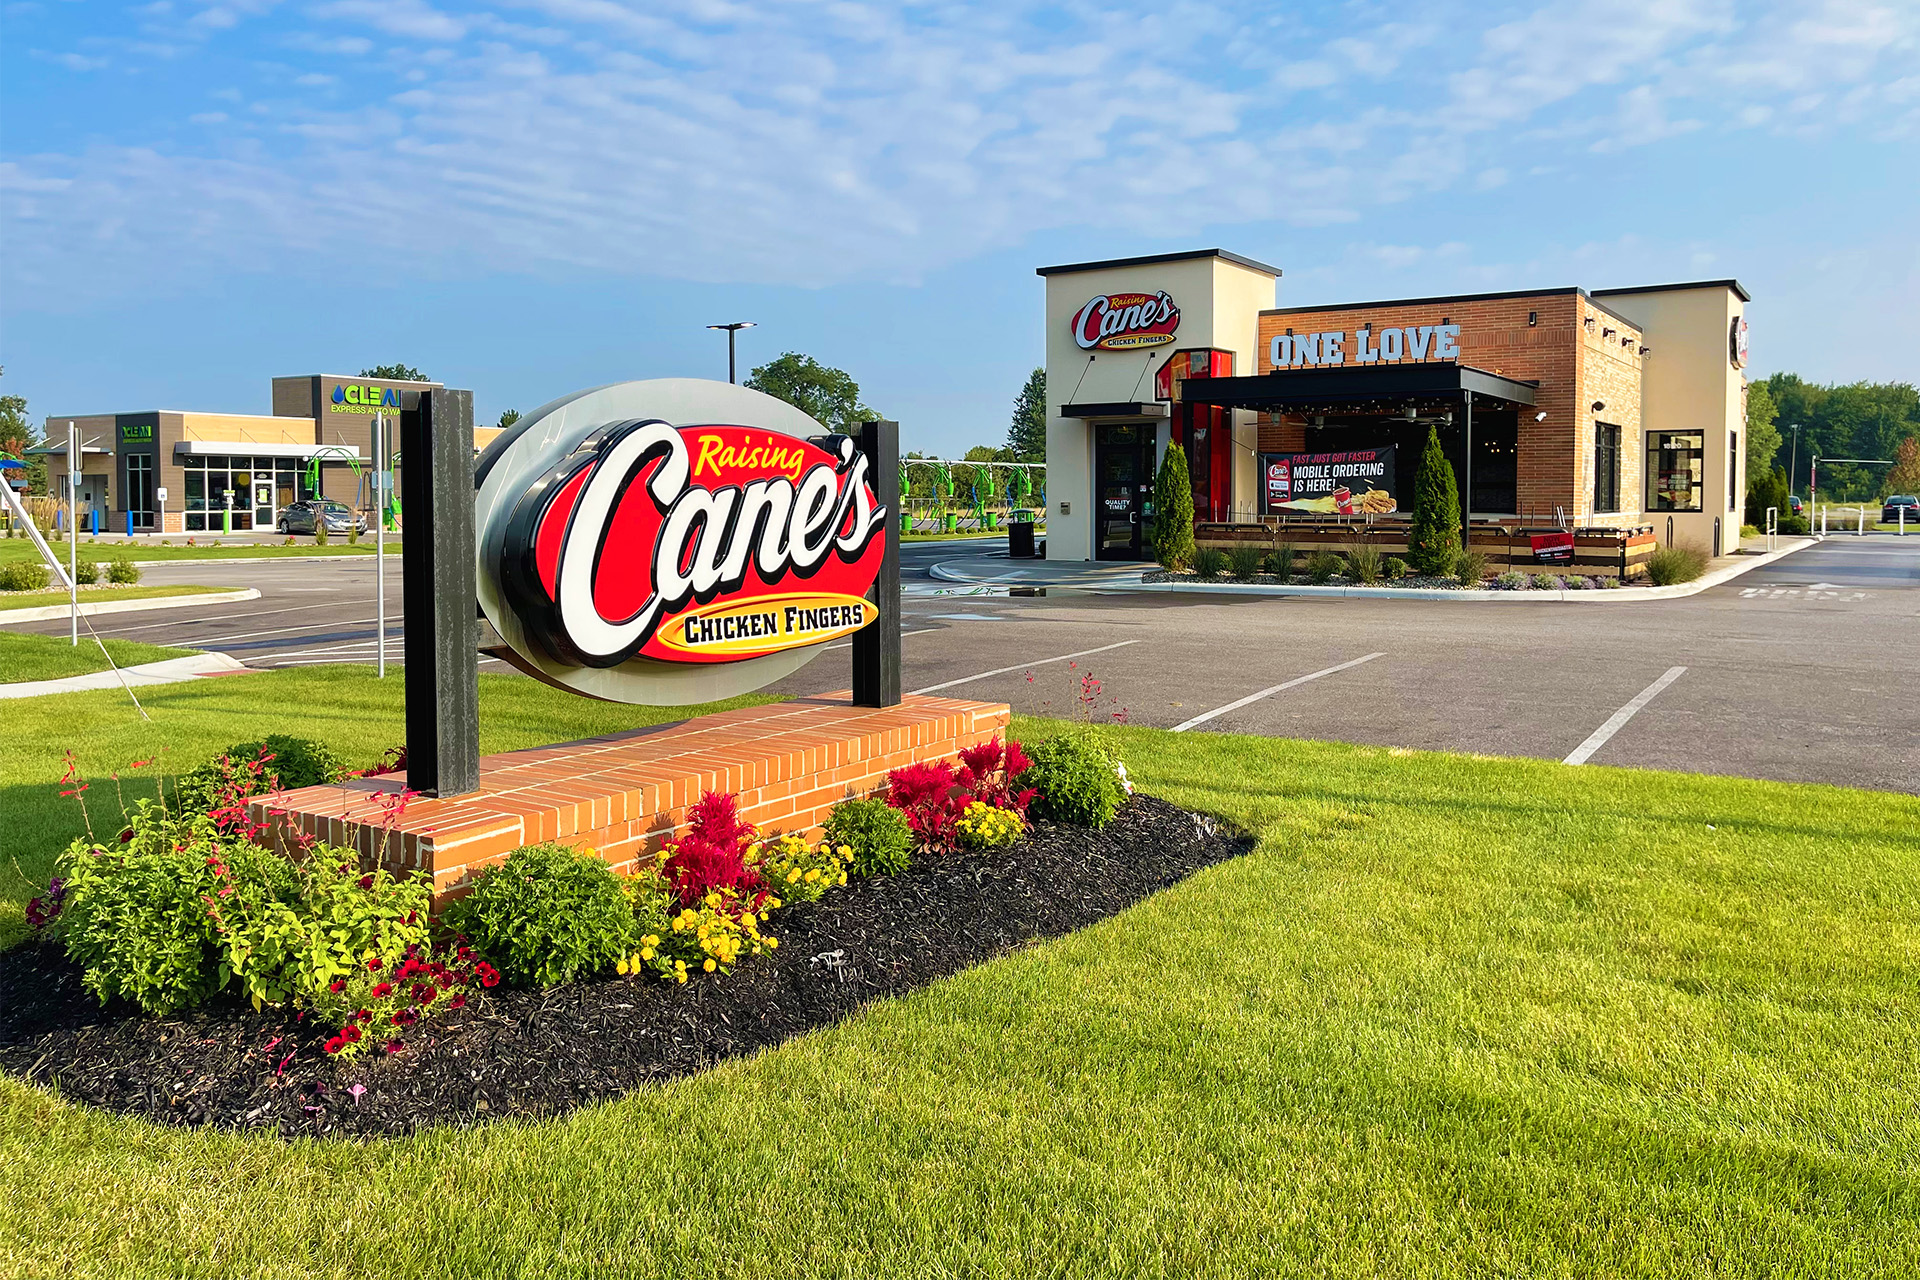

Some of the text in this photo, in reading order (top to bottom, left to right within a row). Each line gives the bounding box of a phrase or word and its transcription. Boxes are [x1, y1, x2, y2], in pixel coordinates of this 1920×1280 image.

[1110, 295, 1146, 309] Raising
[1075, 291, 1177, 348] Cane's
[1107, 336, 1167, 346] CHICKEN FINGERS
[1270, 324, 1460, 366] ONE LOVE
[331, 405, 366, 414] EXPRESS
[694, 434, 804, 480] Raising
[1292, 451, 1376, 464] FAST JUST GOT FASTER
[1293, 463, 1384, 479] MOBILE ORDERING
[1293, 479, 1336, 492] IS HERE!
[560, 423, 887, 656] Cane's
[684, 604, 863, 644] CHICKEN FINGERS
